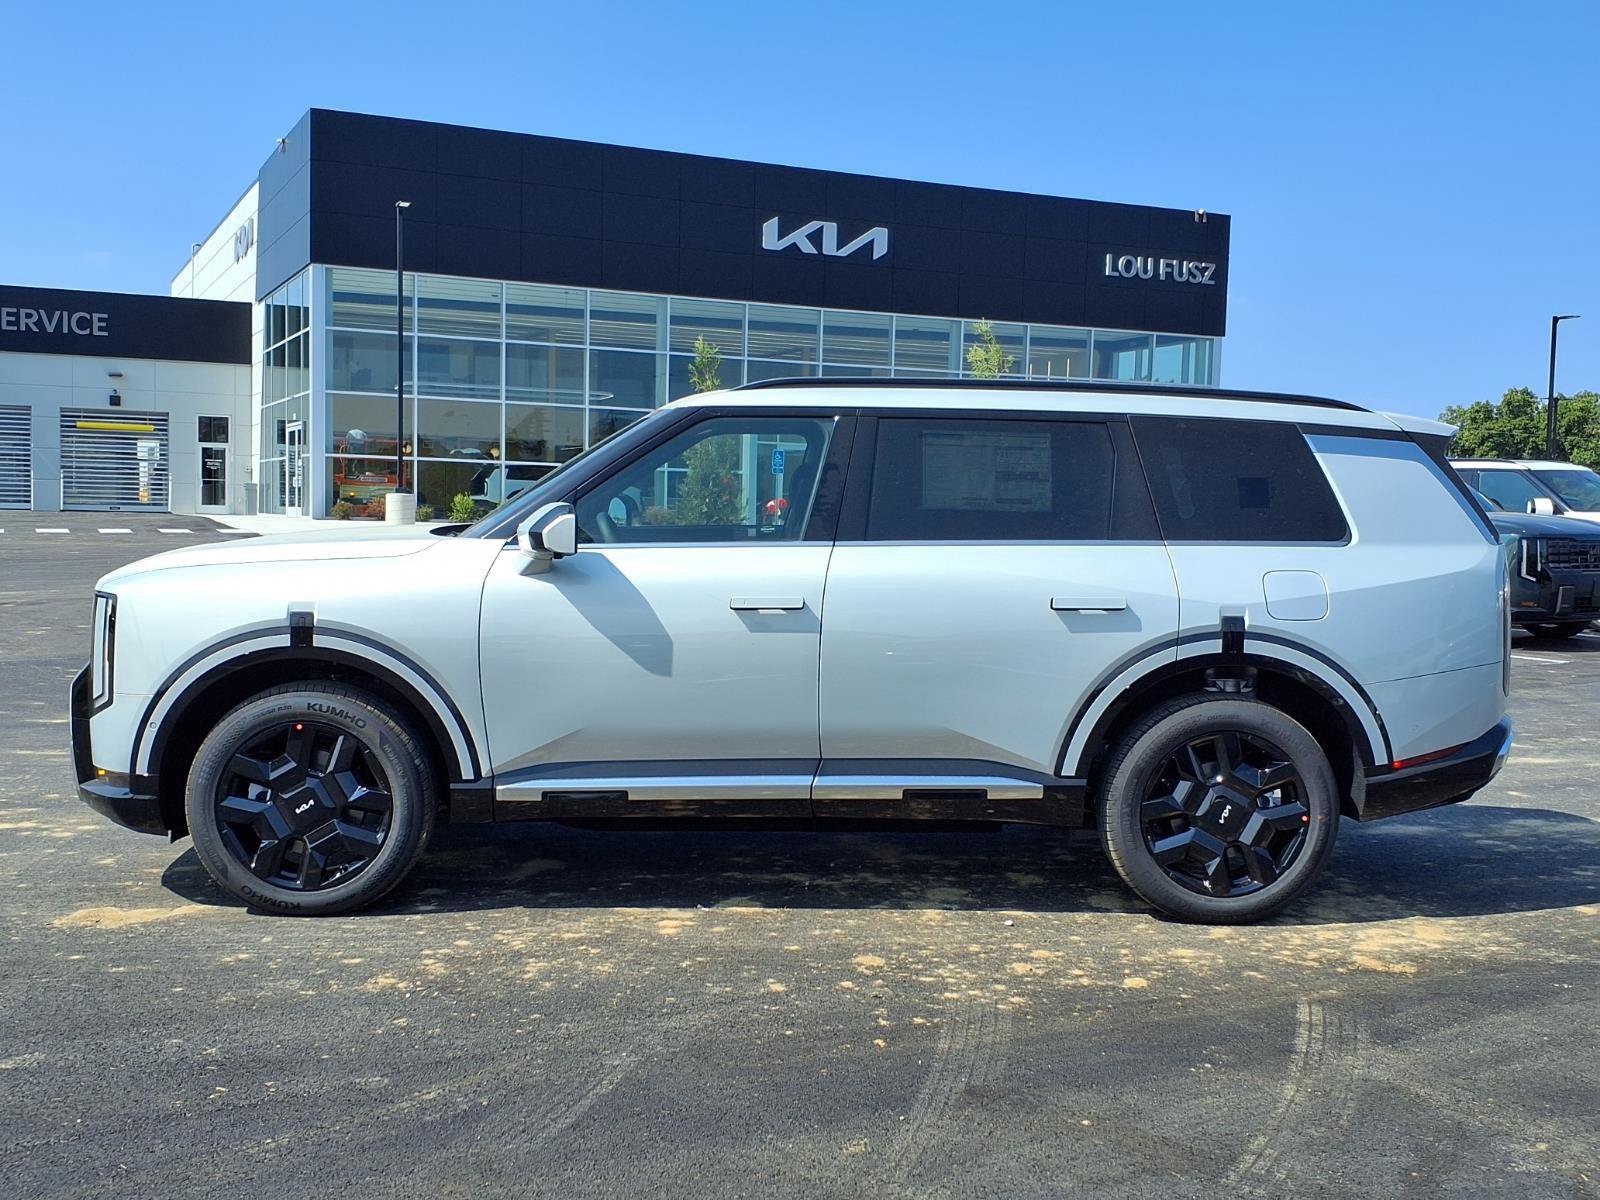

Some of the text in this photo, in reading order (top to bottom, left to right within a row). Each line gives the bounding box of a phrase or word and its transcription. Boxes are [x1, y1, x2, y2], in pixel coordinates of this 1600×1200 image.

[762, 215, 888, 261] KIA
[1105, 253, 1216, 285] LOU FUSZ
[306, 701, 367, 729] KUMHO
[241, 885, 301, 911] KUMHO
